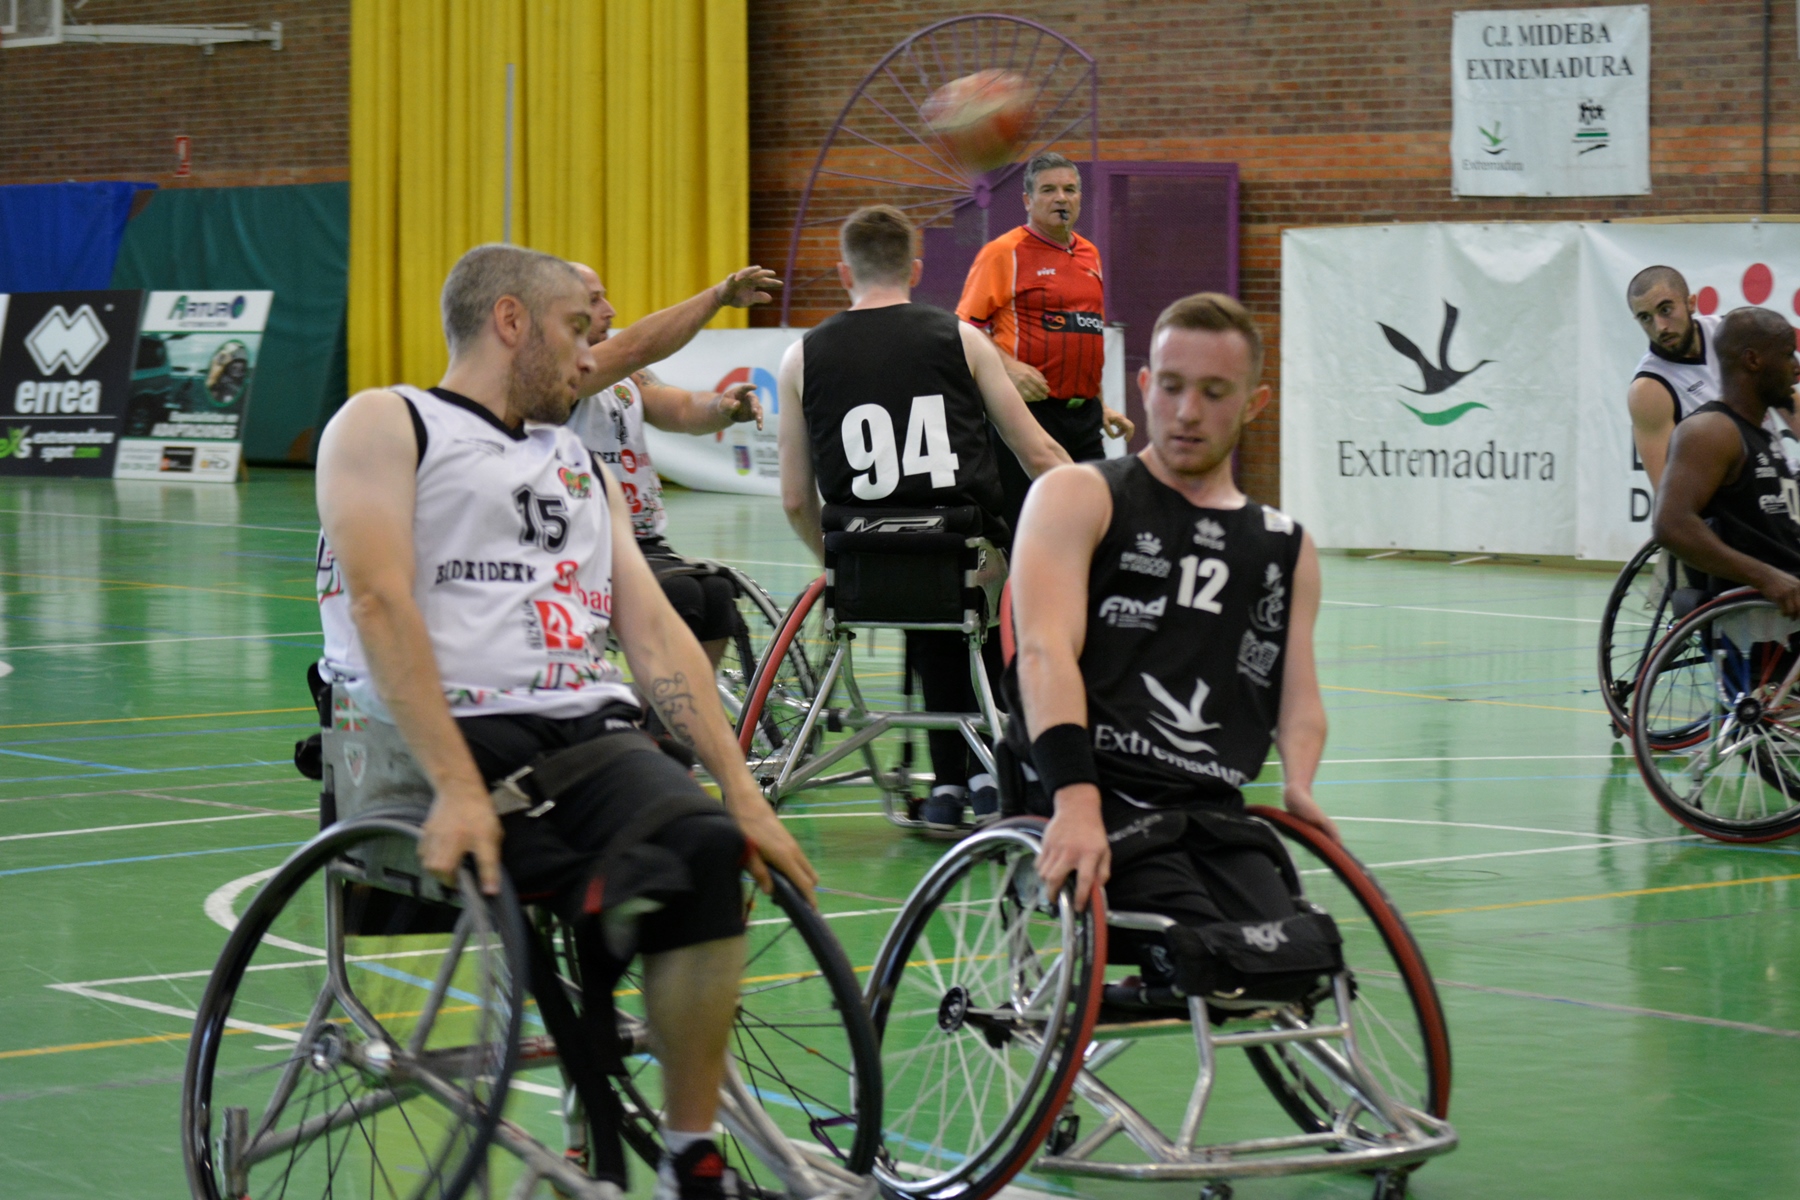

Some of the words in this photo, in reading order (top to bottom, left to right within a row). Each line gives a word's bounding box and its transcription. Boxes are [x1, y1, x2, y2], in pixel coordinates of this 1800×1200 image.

[1518, 22, 1613, 47] MIDEBA
[1466, 55, 1635, 81] EXTREMADURA
[15, 379, 101, 414] errea
[841, 394, 960, 500] 94
[1337, 440, 1556, 481] Extremadura
[512, 484, 571, 554] 15
[435, 560, 536, 585] BIDAIDEAK
[1176, 554, 1230, 615] 12
